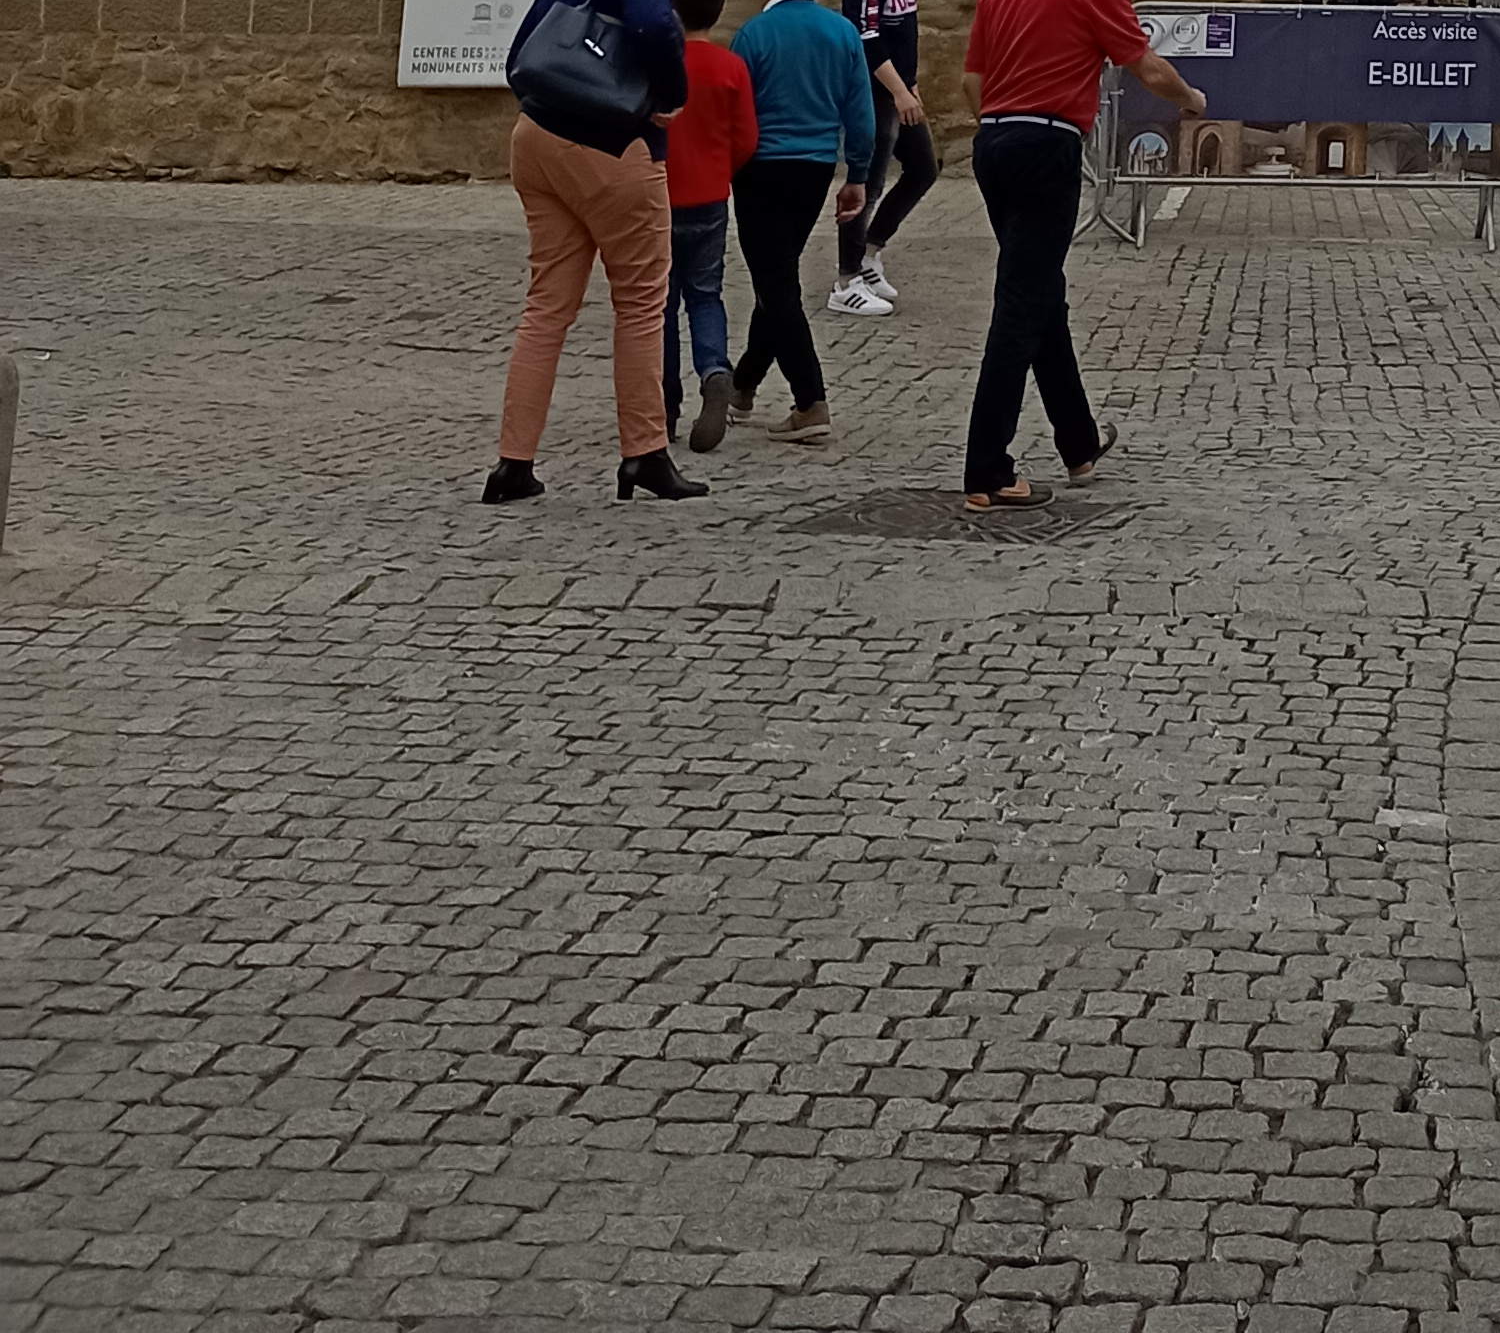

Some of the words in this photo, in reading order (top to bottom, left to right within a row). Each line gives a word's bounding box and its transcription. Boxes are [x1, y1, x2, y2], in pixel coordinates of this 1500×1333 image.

[1373, 21, 1427, 40] Accès
[1432, 23, 1478, 40] visite
[413, 47, 458, 58] CENTRE
[461, 47, 483, 58] DES
[411, 62, 485, 73] MONUMENTS
[1368, 62, 1477, 86] E-BILLET
